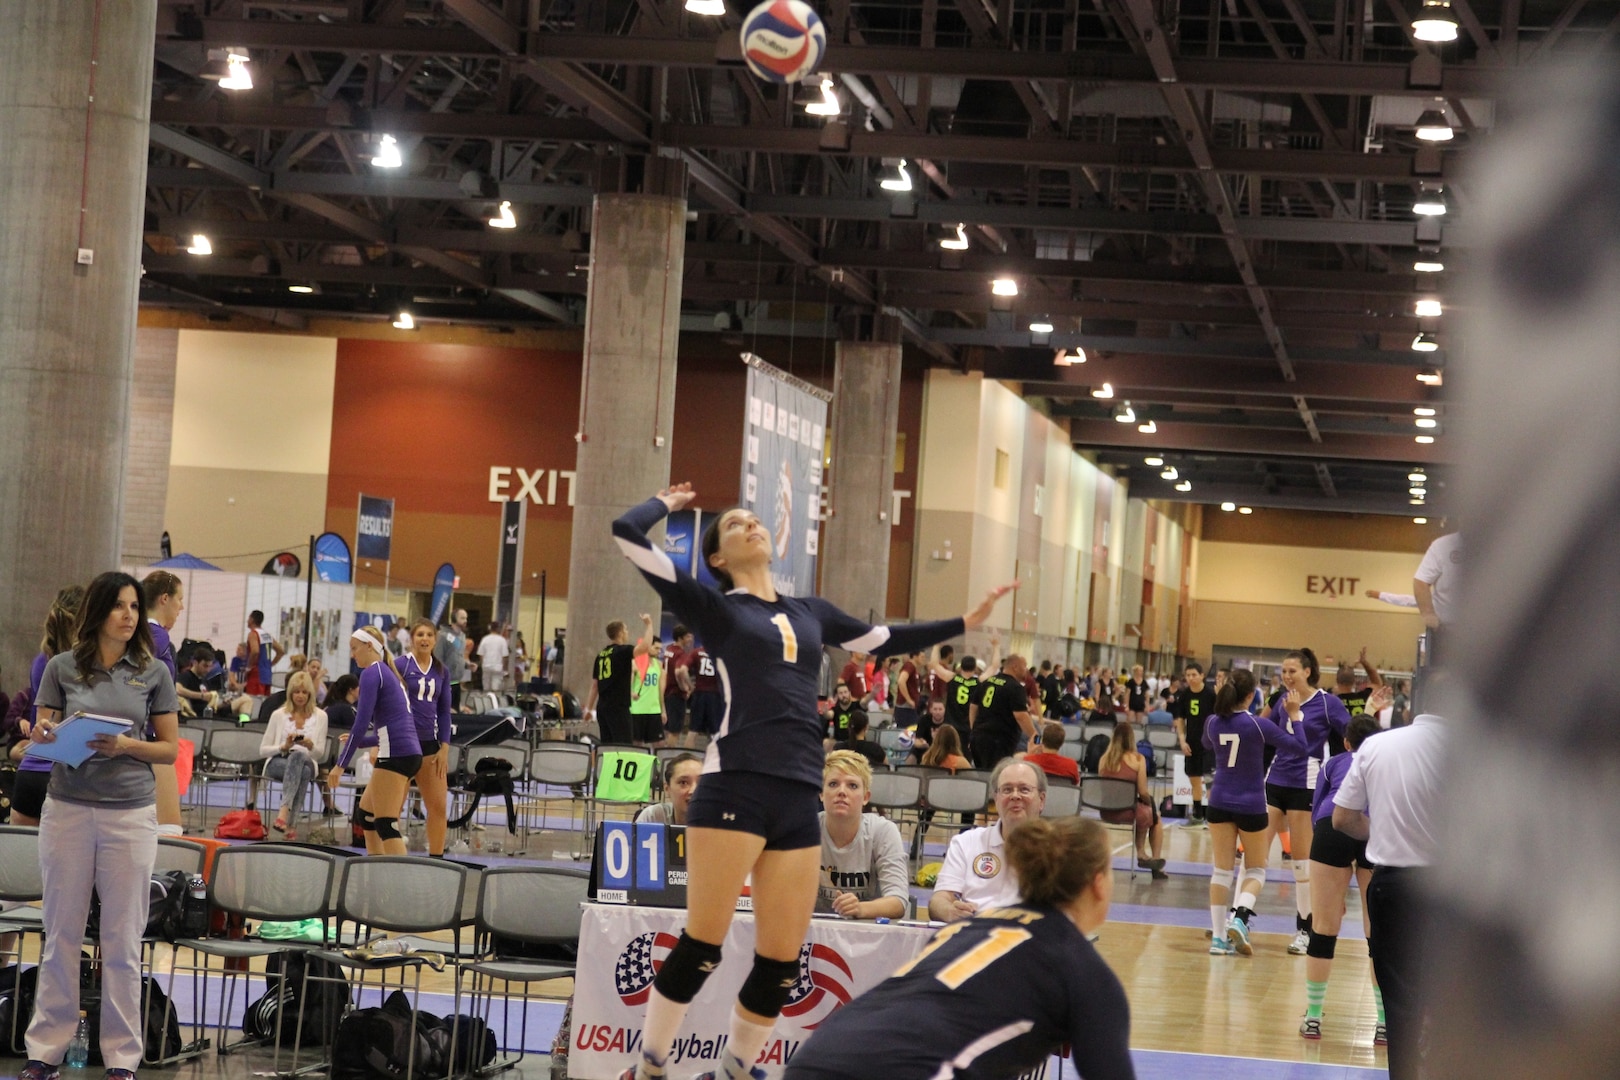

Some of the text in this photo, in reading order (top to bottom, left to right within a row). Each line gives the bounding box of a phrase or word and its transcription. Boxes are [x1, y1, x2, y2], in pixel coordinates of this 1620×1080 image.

[488, 466, 577, 507] EXIT
[359, 515, 391, 537] RESULTS
[1306, 575, 1360, 595] EXIT
[770, 612, 798, 664] 1
[598, 657, 612, 680] 13
[699, 657, 715, 677] 15
[417, 677, 436, 702] 11
[957, 686, 970, 705] 6
[982, 686, 995, 708] 8
[1190, 700, 1200, 716] 5
[1218, 733, 1240, 768] 7
[613, 759, 638, 782] 10
[600, 892, 624, 901] HOME
